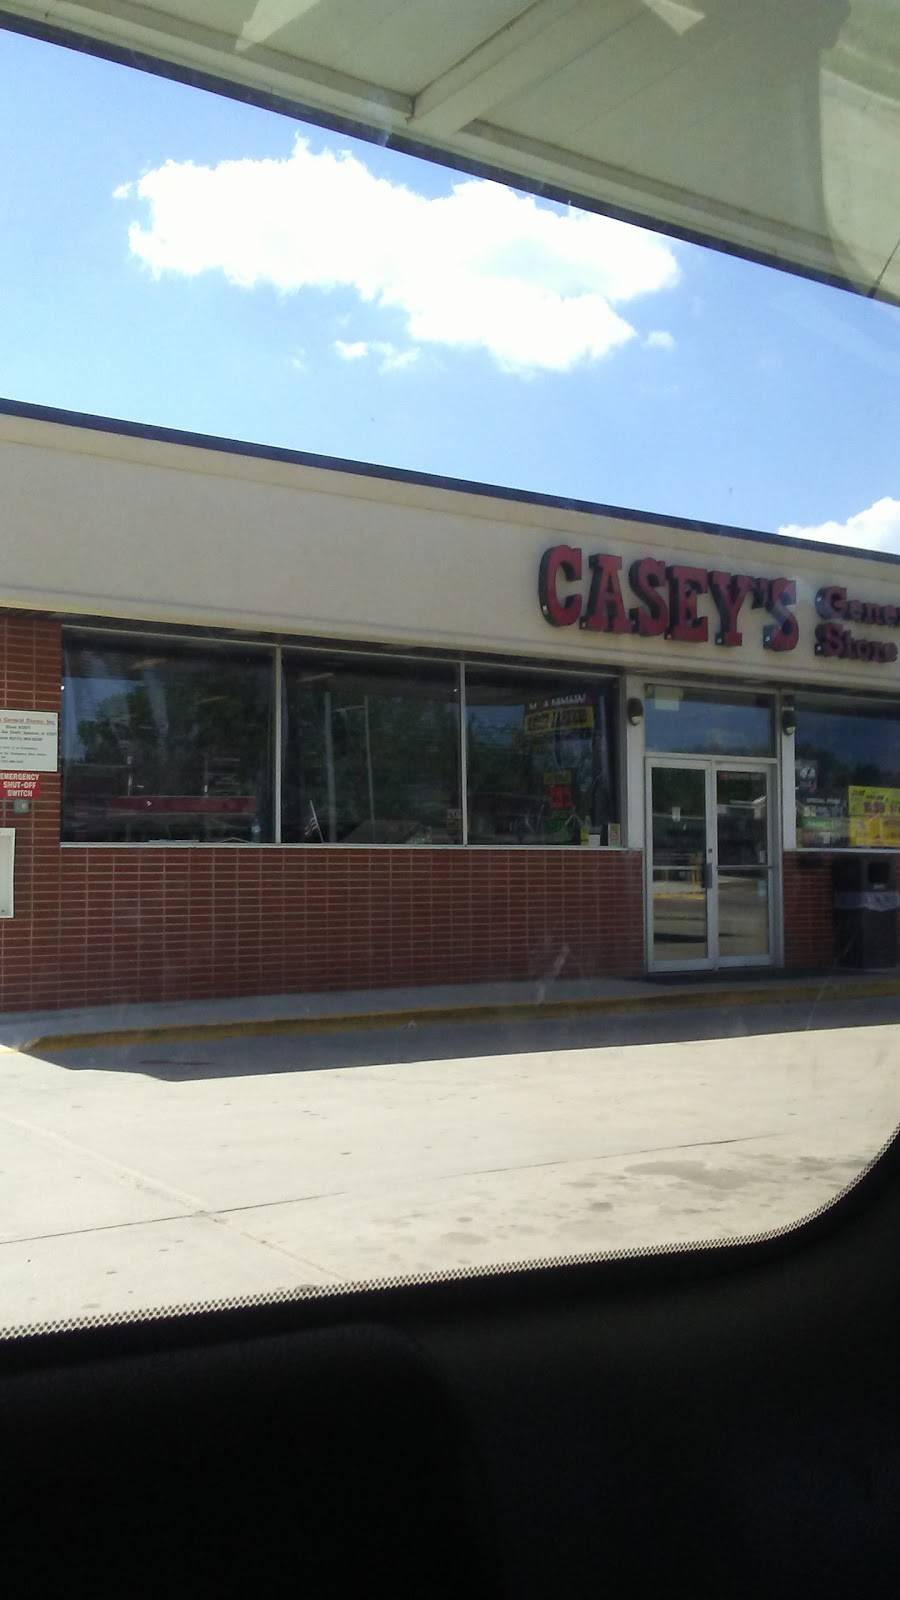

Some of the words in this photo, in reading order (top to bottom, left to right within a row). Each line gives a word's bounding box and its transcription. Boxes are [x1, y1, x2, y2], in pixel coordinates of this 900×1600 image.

[539, 545, 799, 650] CASEY'S
[815, 624, 898, 662] Store
[0, 772, 40, 781] EMERGENCY
[3, 781, 37, 789] SHUT-OFF
[7, 789, 33, 797] SWITCH
